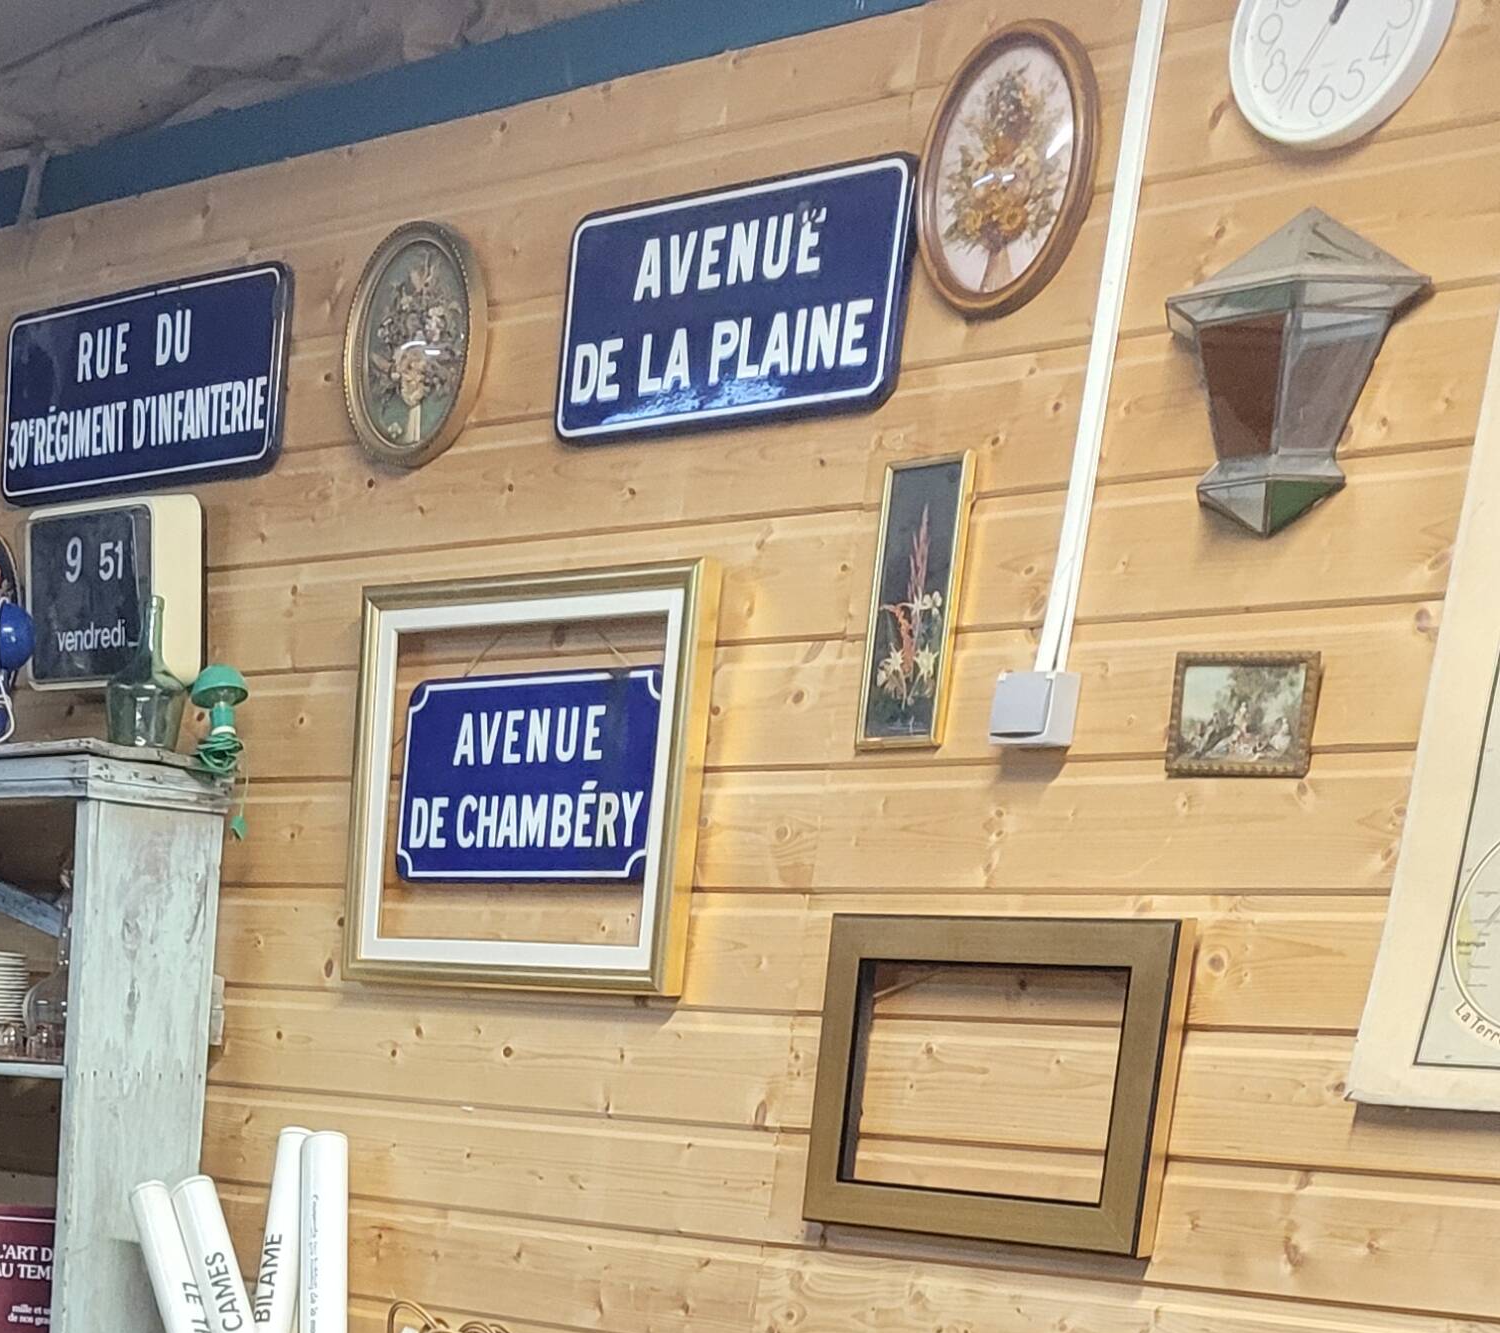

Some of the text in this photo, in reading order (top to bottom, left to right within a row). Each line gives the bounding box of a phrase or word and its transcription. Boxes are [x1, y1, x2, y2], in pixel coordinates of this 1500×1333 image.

[1258, 13, 1283, 57] 9
[1369, 29, 1391, 67] 4
[1262, 49, 1288, 94] 8
[1339, 58, 1366, 102] 5
[1309, 74, 1337, 118] 6
[633, 206, 827, 302] AVENUE
[77, 309, 192, 383] RUE DU
[570, 298, 874, 406] DE LA PLAINE
[34, 401, 127, 466] RÉGIMENT
[132, 375, 268, 450] D'INFANTERIE
[65, 536, 124, 583] 9 51
[57, 618, 126, 652] vendredi
[453, 704, 607, 766] AVENUE
[408, 780, 644, 849] DE CHAMBÉRY
[1455, 1001, 1500, 1045] La Terr
[17, 1263, 51, 1280] TEM
[41, 1247, 53, 1262] D
[182, 1282, 204, 1306] LE
[204, 1251, 243, 1332] CAMES
[254, 1233, 283, 1324] BILAME
[8, 1313, 51, 1327] de nos gra
